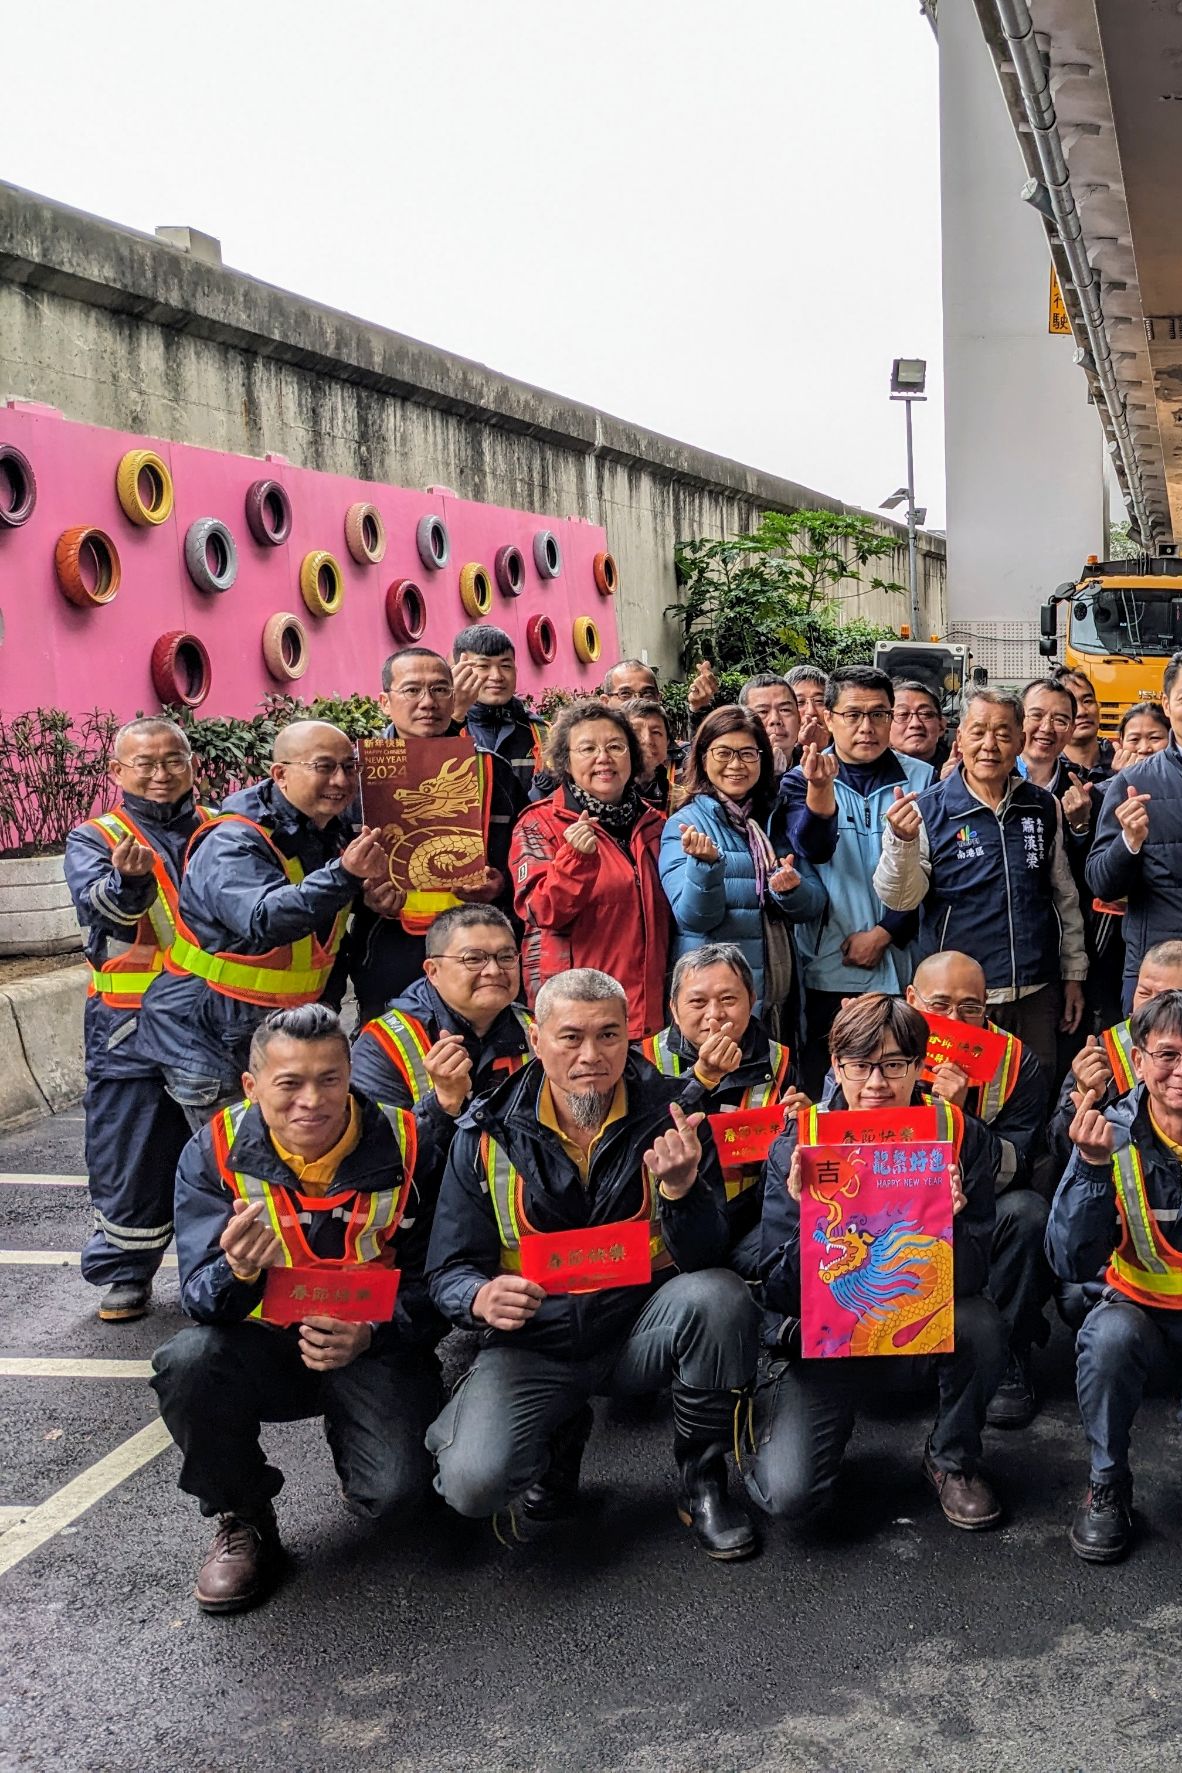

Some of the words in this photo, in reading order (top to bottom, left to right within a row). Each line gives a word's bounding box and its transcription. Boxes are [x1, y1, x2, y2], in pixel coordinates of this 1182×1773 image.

[1138, 690, 1164, 700] ISU
[364, 739, 406, 748] 新年快樂
[386, 755, 408, 763] YEAR
[367, 766, 407, 779] 2024
[957, 846, 985, 860] 南港區
[816, 1160, 841, 1184] 吉
[876, 1179, 901, 1188] HAPPY
[904, 1178, 920, 1187] NEW
[924, 1177, 943, 1186] YEAR
